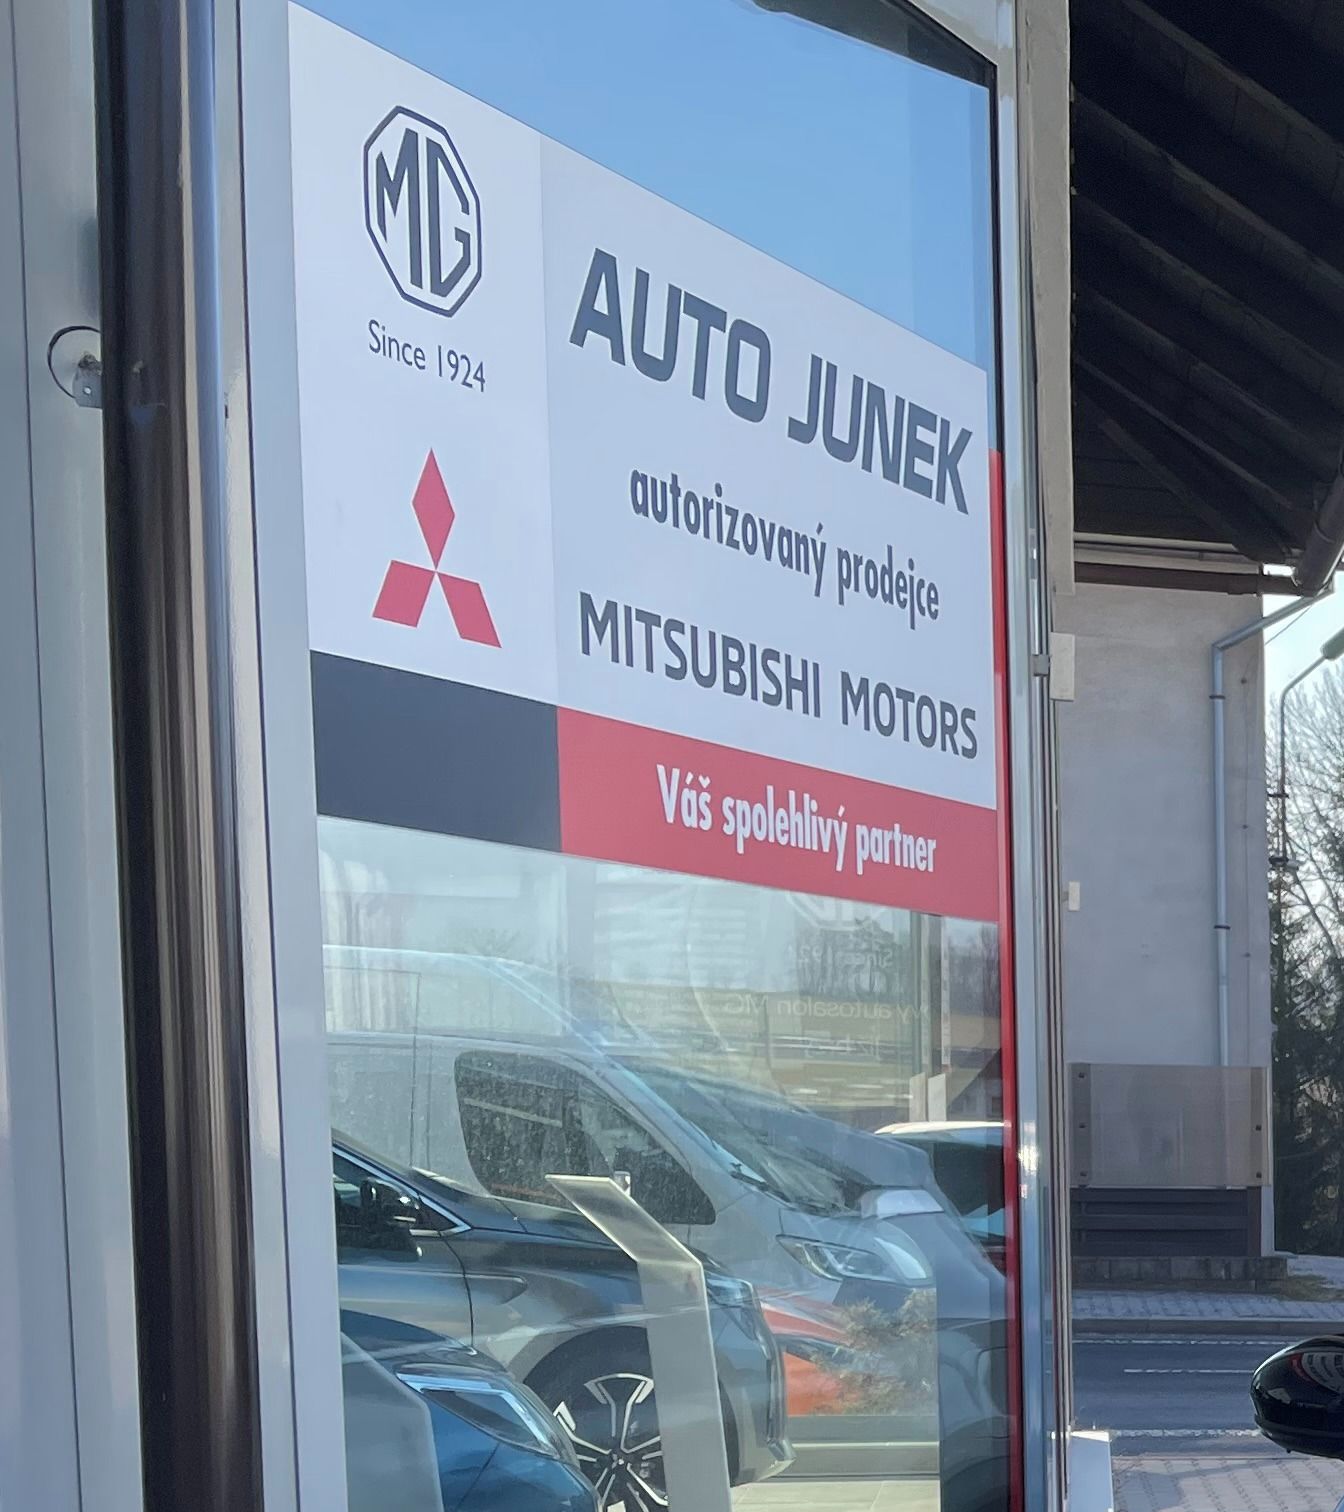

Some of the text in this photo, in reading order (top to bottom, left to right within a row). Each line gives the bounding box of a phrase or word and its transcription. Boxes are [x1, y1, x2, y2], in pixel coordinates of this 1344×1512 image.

[374, 126, 472, 298] MG
[367, 318, 486, 393] Since 1924
[568, 247, 974, 515] AUTO JUNEK
[630, 468, 940, 630] autorizovaný prodejce
[579, 590, 978, 760] MITSUBISHI MOTORS
[656, 763, 938, 876] Váš spolehlivý partner
